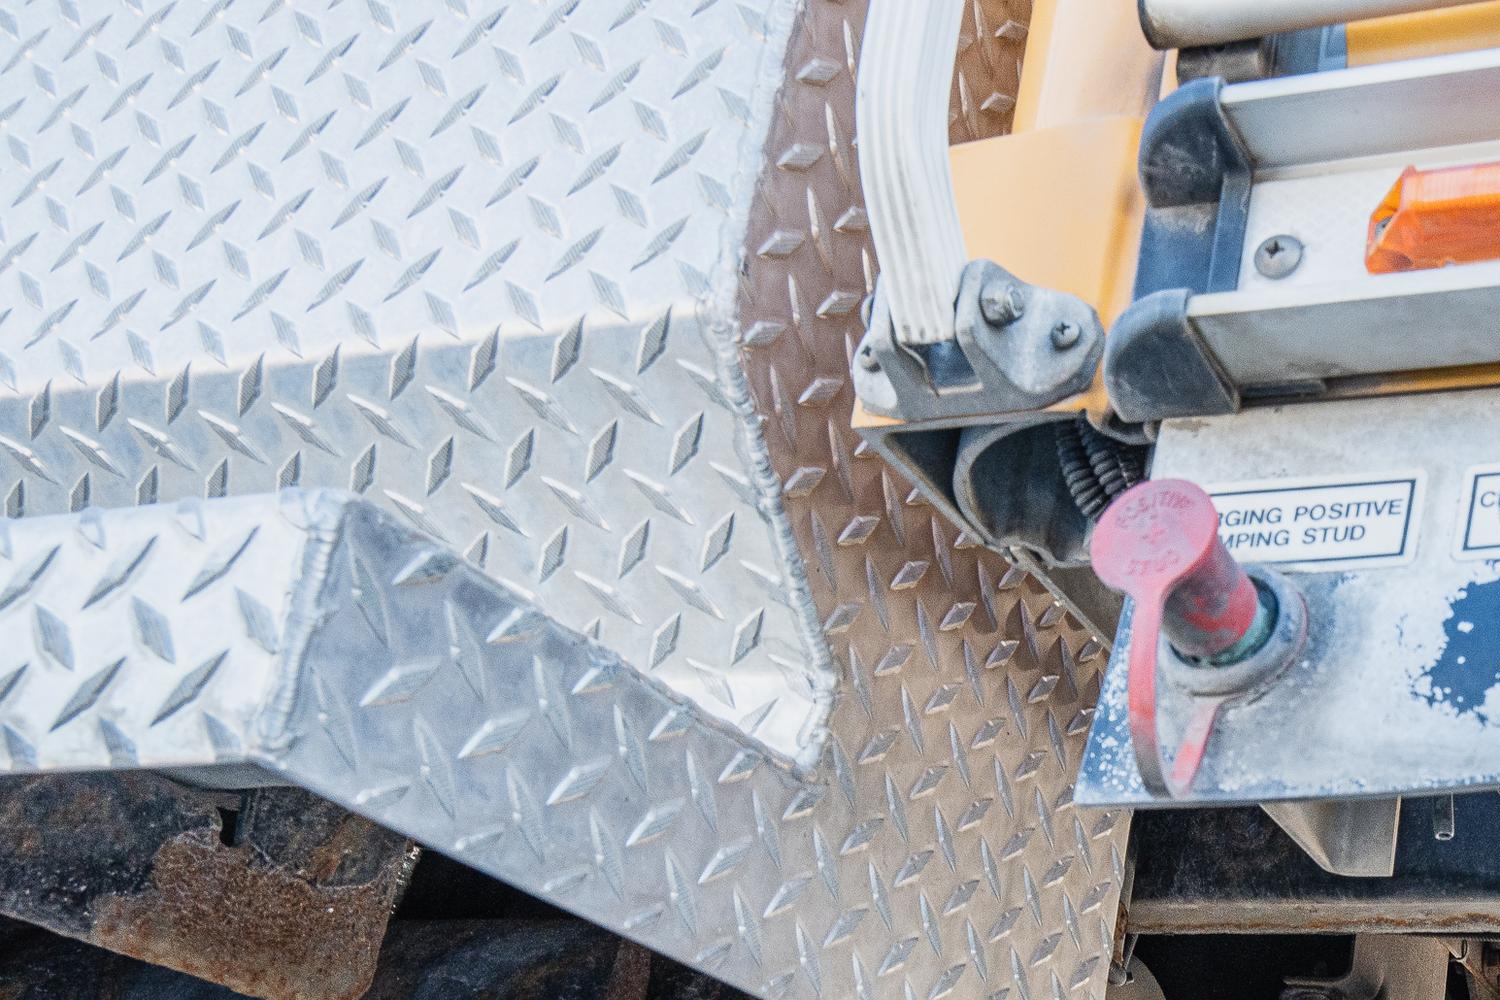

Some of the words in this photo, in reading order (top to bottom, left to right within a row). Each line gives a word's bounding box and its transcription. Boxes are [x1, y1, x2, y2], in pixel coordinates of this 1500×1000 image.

[1217, 507, 1282, 527] RGING
[1294, 498, 1404, 523] POSITIVE
[1218, 529, 1290, 549] MPING
[1302, 524, 1366, 545] STUD
